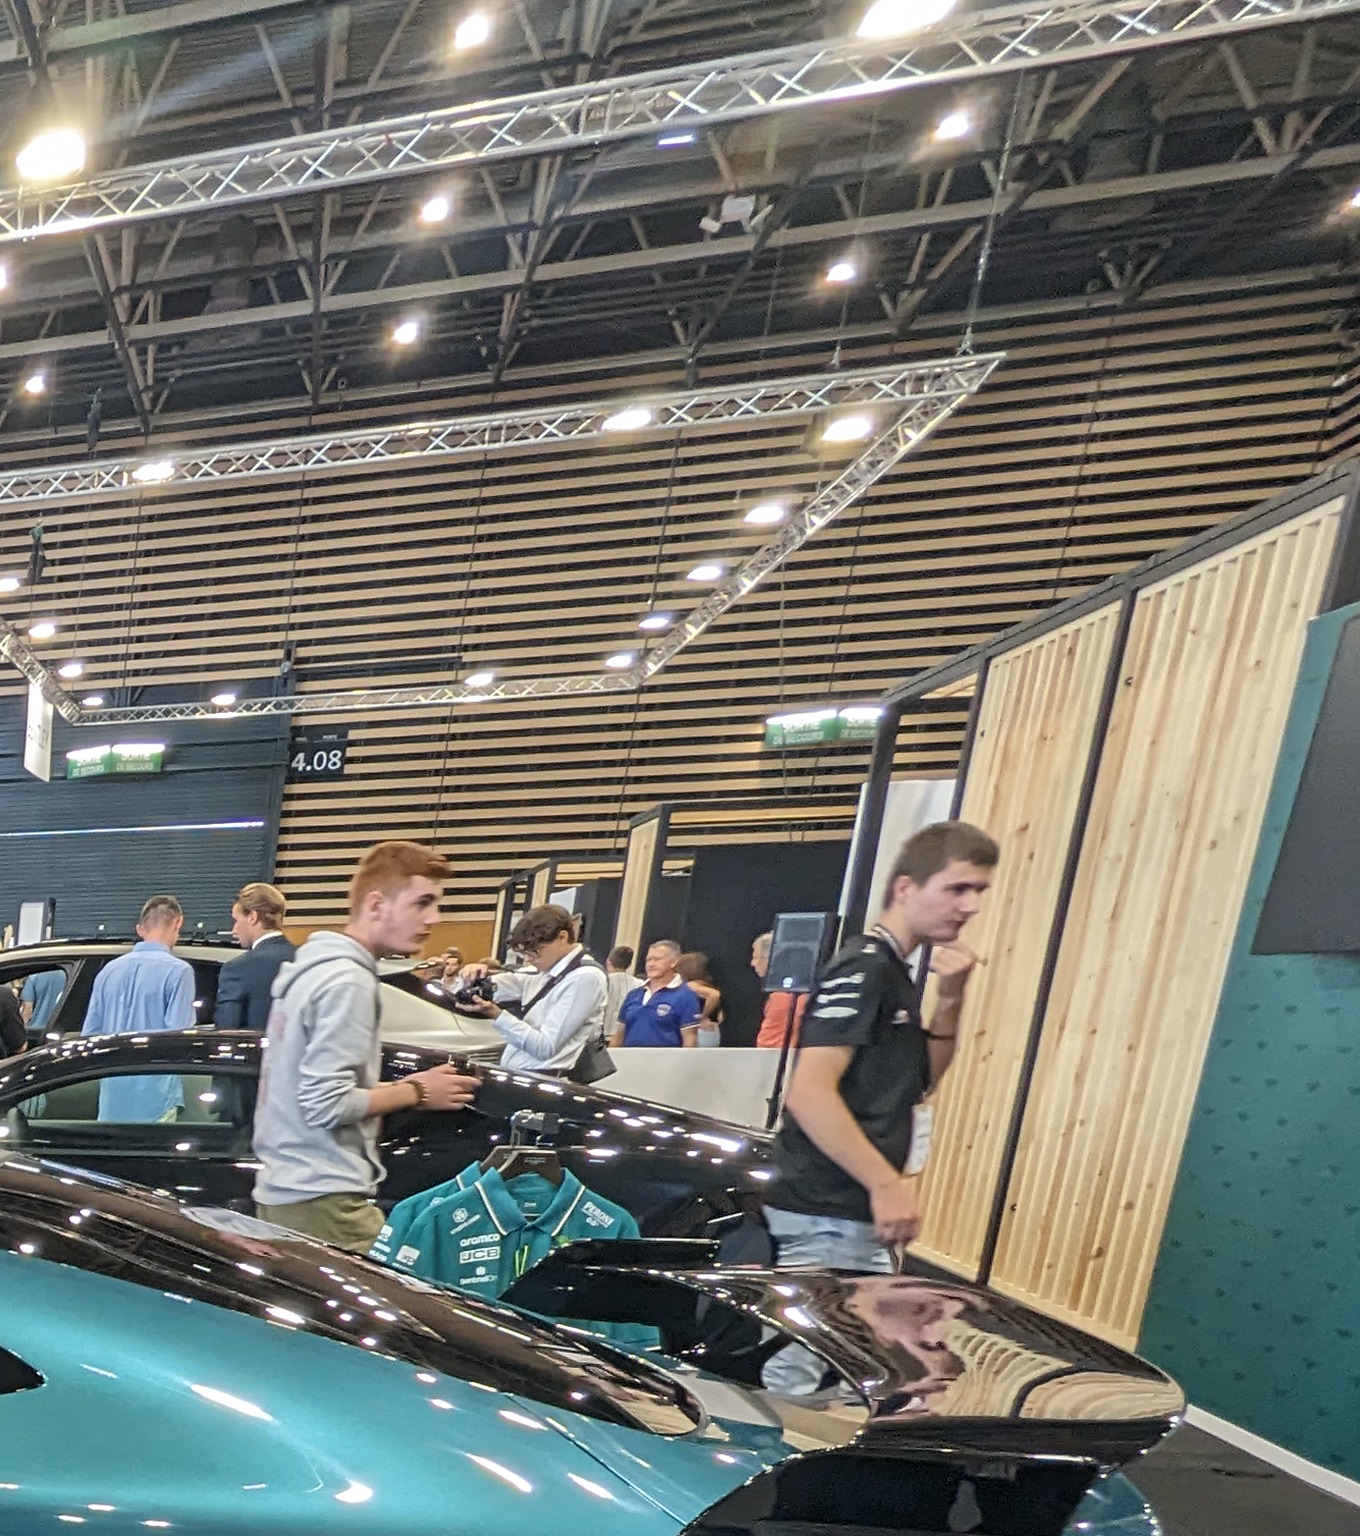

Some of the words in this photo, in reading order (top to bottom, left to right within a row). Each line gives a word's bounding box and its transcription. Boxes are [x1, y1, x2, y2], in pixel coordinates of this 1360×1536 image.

[291, 749, 342, 771] 4.08
[460, 1233, 501, 1247] aramco
[461, 1248, 499, 1262] JCB
